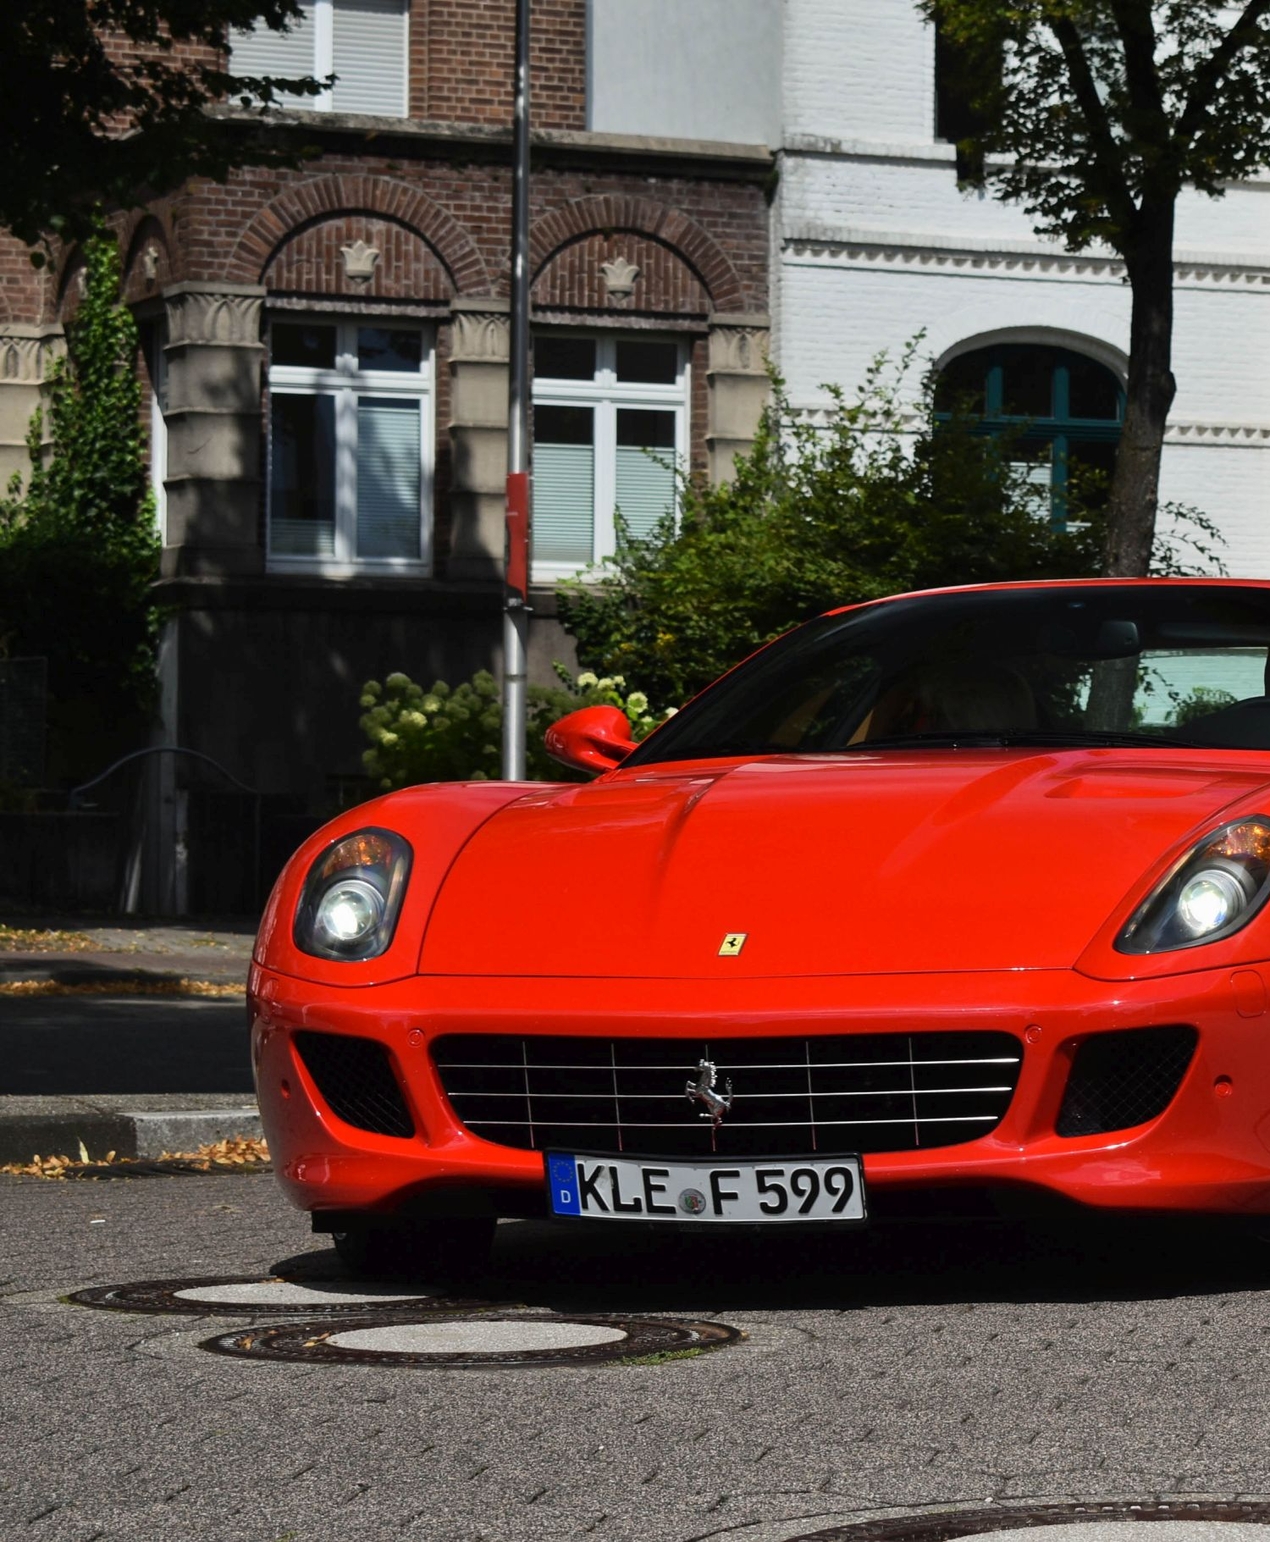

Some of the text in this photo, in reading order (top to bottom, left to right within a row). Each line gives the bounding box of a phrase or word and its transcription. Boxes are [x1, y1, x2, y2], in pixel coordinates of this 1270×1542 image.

[560, 1190, 571, 1204] D
[577, 1162, 854, 1215] KLE F 599
